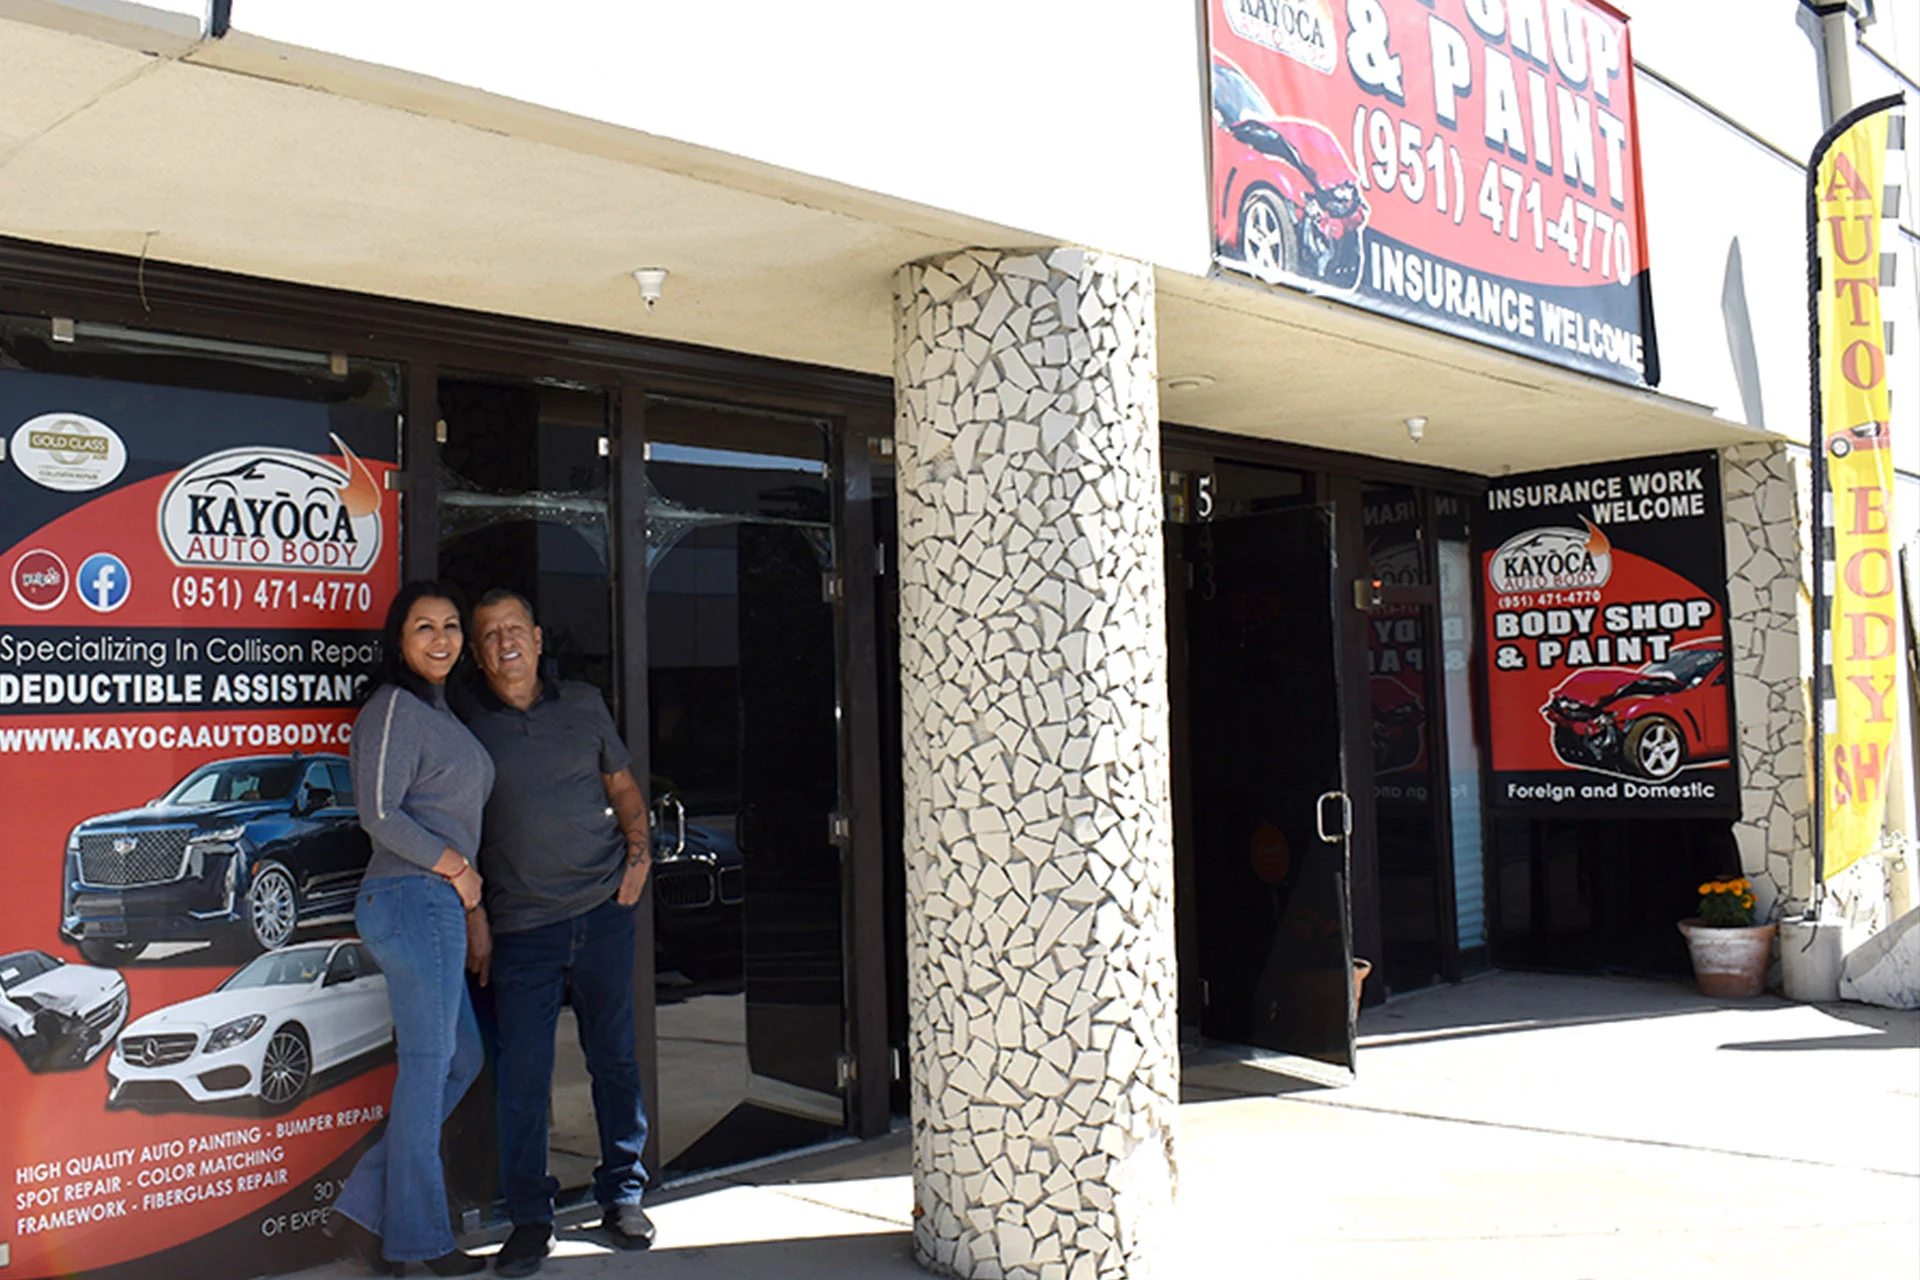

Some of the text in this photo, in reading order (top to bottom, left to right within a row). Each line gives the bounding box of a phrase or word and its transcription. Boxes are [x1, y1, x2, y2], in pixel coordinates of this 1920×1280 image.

[1345, 0, 1627, 212] & PAINT
[1353, 105, 1632, 288] (951) 471-4770
[1822, 151, 1886, 390] AUTO
[1370, 241, 1645, 377] INSURANCE WELCOME
[32, 433, 106, 452] GOLD CLASS
[1488, 468, 1704, 511] INSURANCE WORK
[1592, 494, 1705, 525] WELCOME
[187, 535, 359, 567] AUTO BODY
[171, 576, 372, 612] (951) 471-4770
[1504, 571, 1599, 591] AUTO BODY
[1498, 590, 1602, 609] (951) 471-4770
[1496, 600, 1714, 638] BODY SHOP
[0, 634, 384, 668] Specializing In Collison Repai
[1496, 634, 1672, 669] & PAINT
[0, 673, 202, 704] DEDUCTIBLE
[1508, 780, 1716, 802] Foreign and Domestic
[15, 1157, 61, 1185] HIGH
[65, 1147, 135, 1176] QUALITY
[139, 1138, 184, 1164] AUTO
[188, 1125, 262, 1155] PAINTING
[276, 1113, 334, 1140] BUMPER
[336, 1104, 385, 1129] REPAIR
[15, 1184, 61, 1212] SPOT
[64, 1174, 122, 1202] REPAIR
[137, 1161, 196, 1188] COLOR
[199, 1145, 285, 1177] MATCHING
[312, 1180, 335, 1202] 30
[17, 1202, 127, 1236] FRAMEWORK
[142, 1180, 234, 1212] FIBERGLASS
[237, 1168, 289, 1193] REPAIR
[260, 1214, 288, 1238] OF
